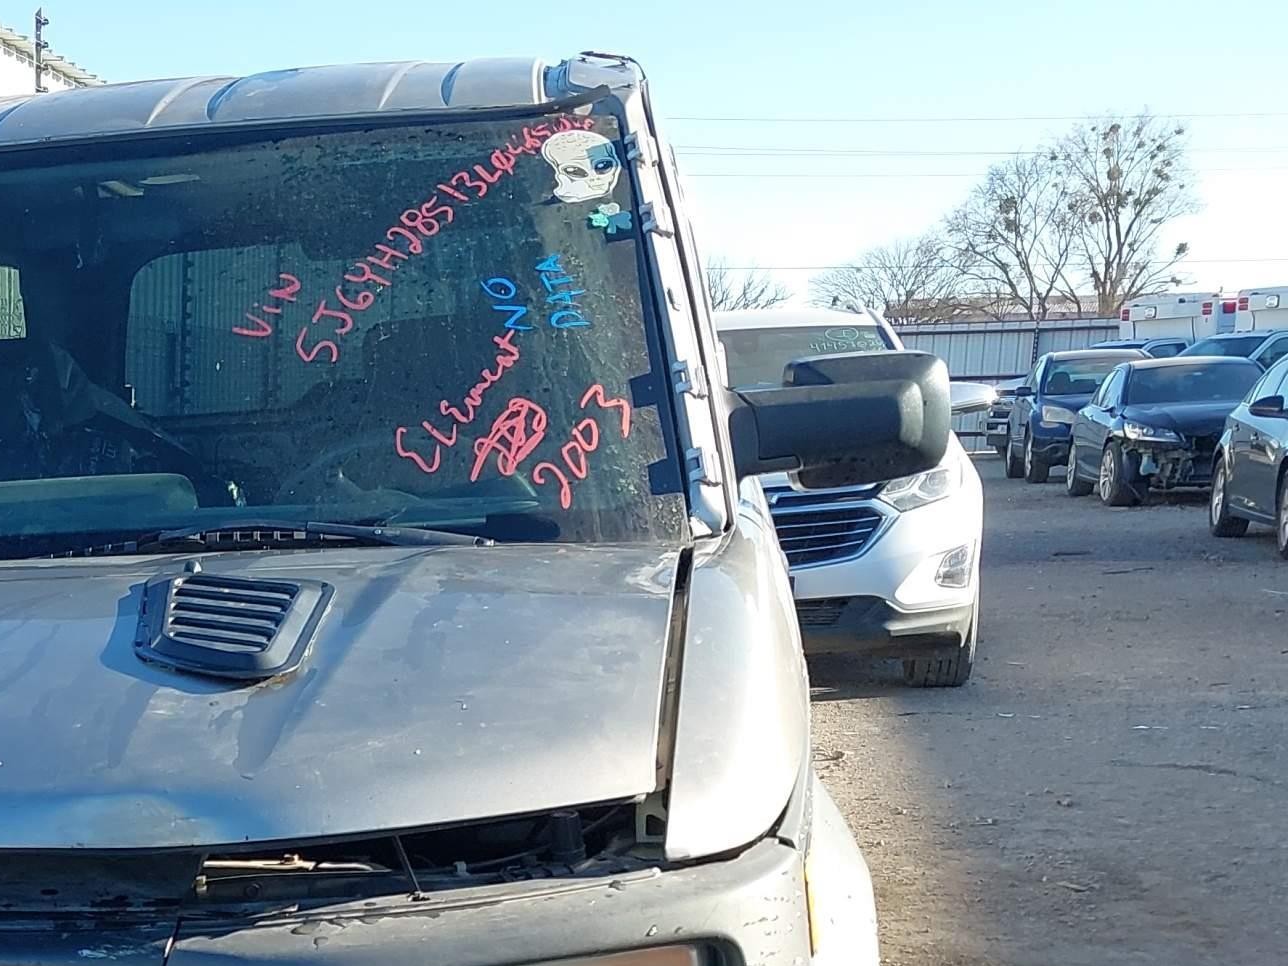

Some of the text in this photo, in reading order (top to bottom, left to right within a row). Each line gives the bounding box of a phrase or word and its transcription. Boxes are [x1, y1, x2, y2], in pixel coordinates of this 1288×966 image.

[480, 277, 535, 331] NO
[535, 254, 592, 329] DATA
[532, 384, 631, 509] 2003
